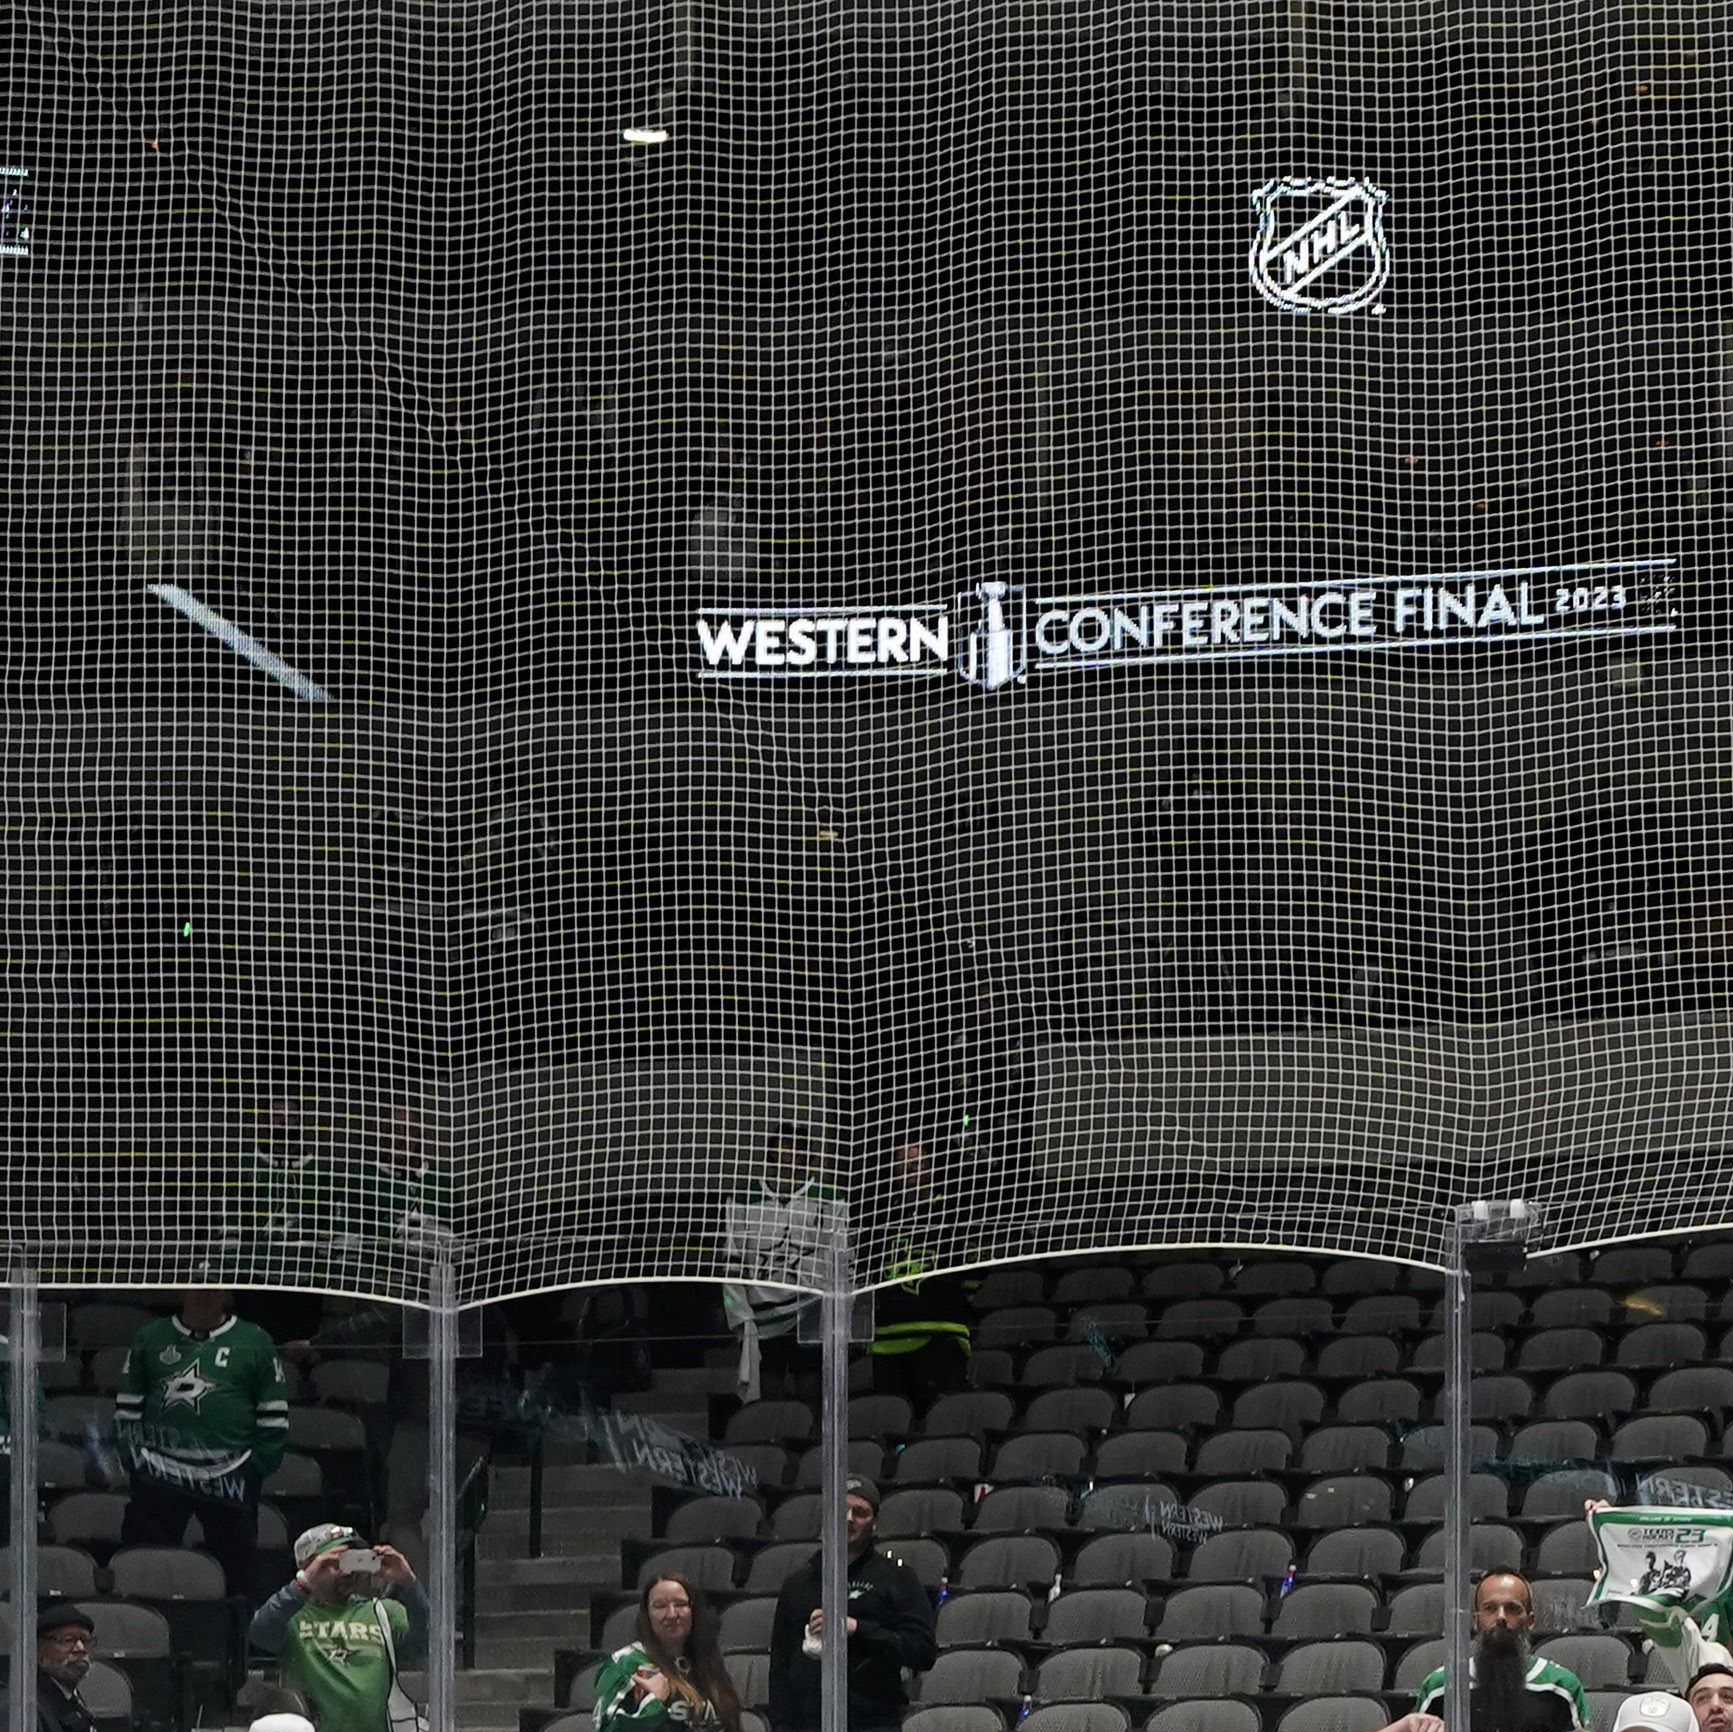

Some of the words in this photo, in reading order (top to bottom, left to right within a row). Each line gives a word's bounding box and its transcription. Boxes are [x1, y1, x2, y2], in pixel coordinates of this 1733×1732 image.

[696, 616, 949, 666] WESTERN
[1034, 592, 1378, 654] CONFERENCE
[1394, 580, 1545, 633] FINAL
[1554, 585, 1627, 612] 2023
[216, 1346, 232, 1368] C
